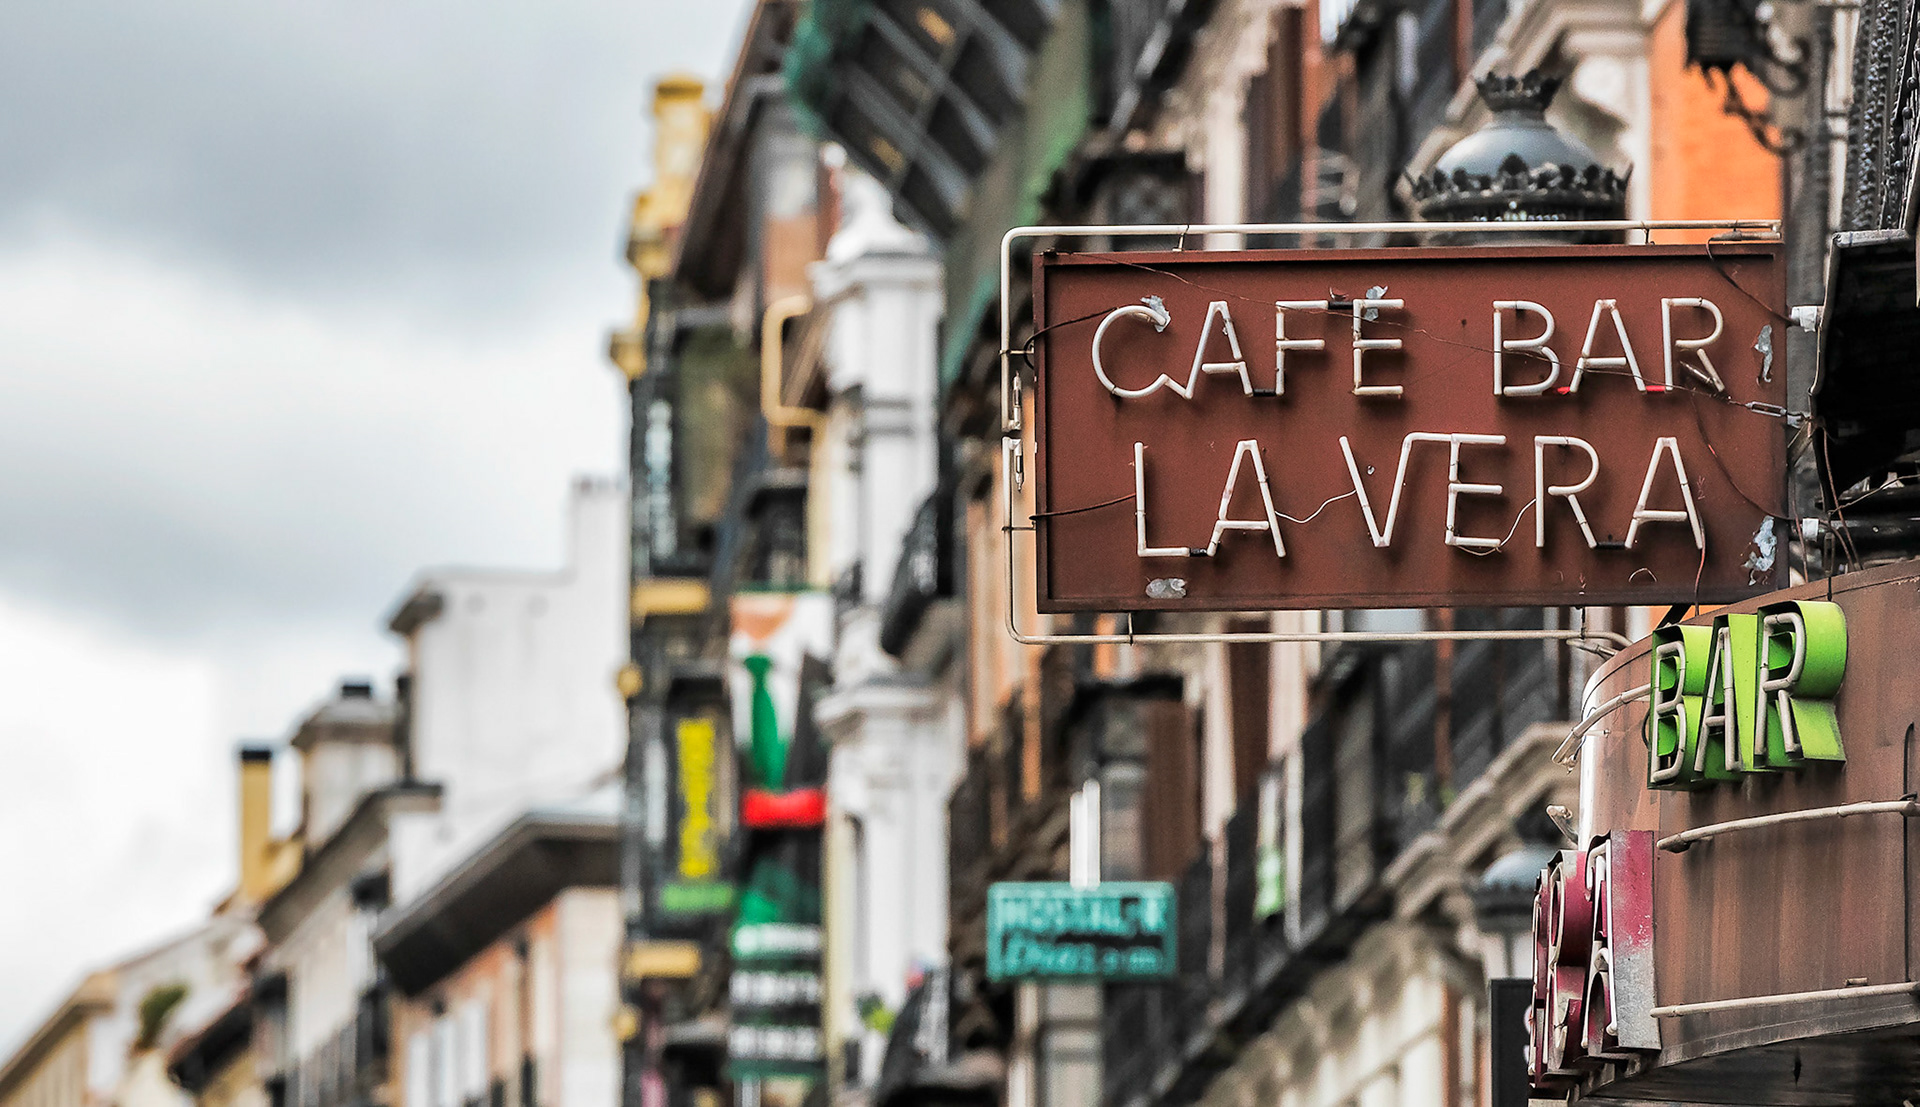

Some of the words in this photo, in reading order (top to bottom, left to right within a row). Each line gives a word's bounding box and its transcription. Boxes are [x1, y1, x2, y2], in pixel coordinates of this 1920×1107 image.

[1091, 299, 1406, 400] CAFE
[1493, 297, 1725, 397] BAR
[1133, 438, 1287, 558] LA
[1338, 432, 1703, 550] VERA
[1648, 600, 1847, 790] BAR
